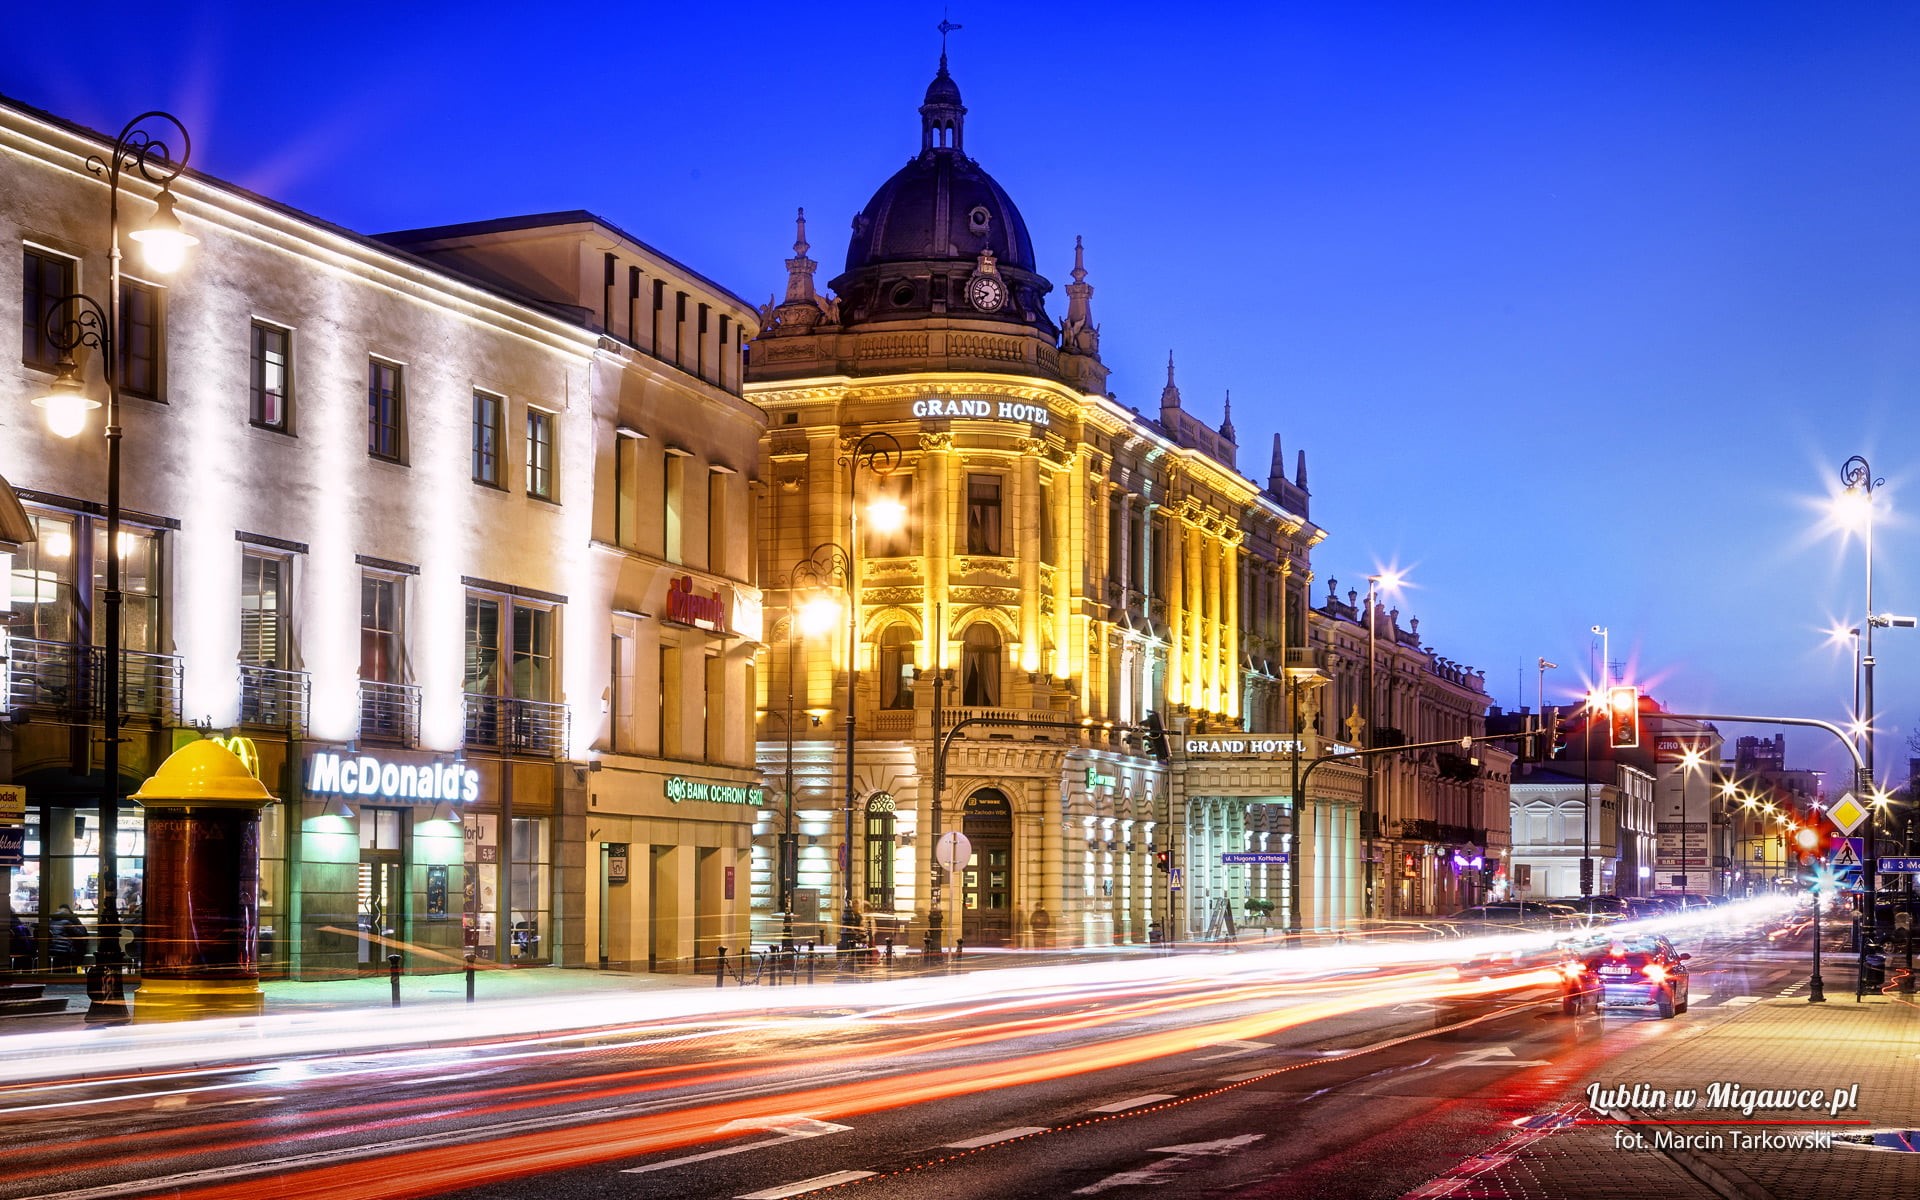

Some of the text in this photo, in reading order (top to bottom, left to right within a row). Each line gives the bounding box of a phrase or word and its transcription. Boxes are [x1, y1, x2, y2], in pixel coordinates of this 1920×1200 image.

[912, 400, 1050, 425] GRAND HOTEL
[1186, 740, 1307, 753] GRAND HOTEL
[311, 752, 480, 802] McDonald's
[687, 781, 709, 801] BANK
[710, 785, 747, 804] OCHRONY
[1233, 855, 1256, 863] Hugona
[1882, 861, 1894, 869] ul.
[1898, 861, 1904, 869] 3
